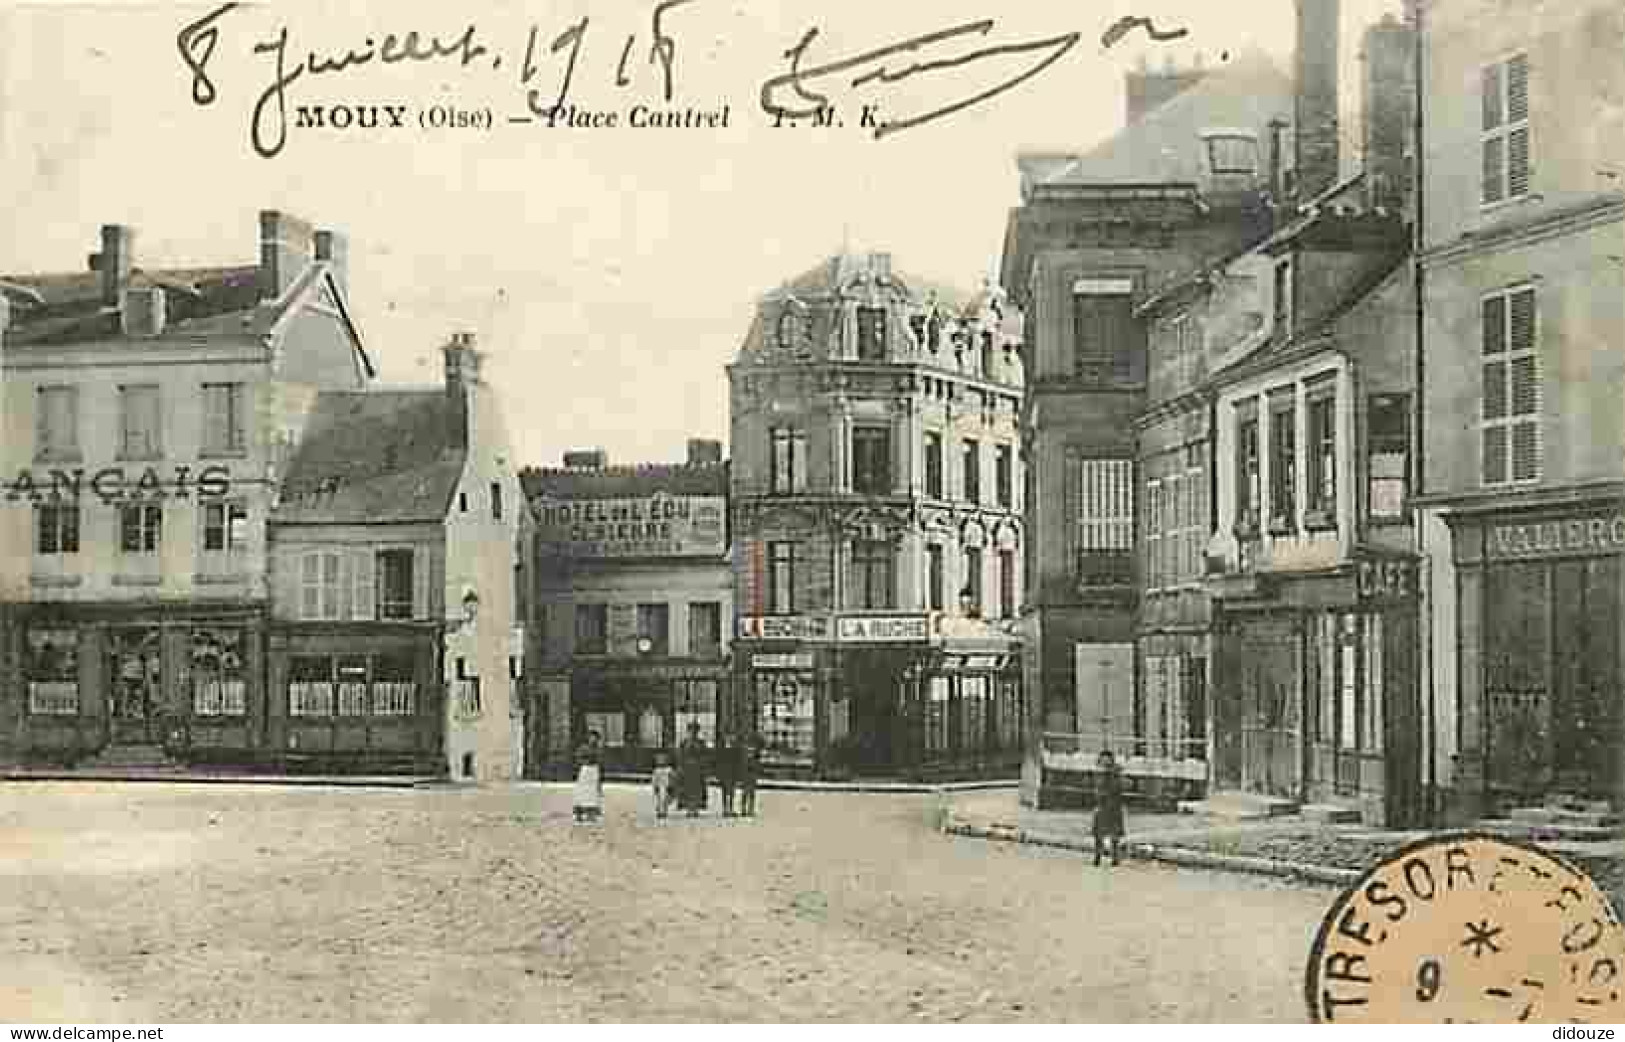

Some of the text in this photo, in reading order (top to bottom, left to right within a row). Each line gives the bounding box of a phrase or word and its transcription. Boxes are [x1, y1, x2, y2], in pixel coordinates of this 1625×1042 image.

[295, 104, 406, 128] MOUY
[546, 105, 619, 128] Place
[629, 105, 730, 128] Cantrel
[1416, 959, 1441, 1002] 9
